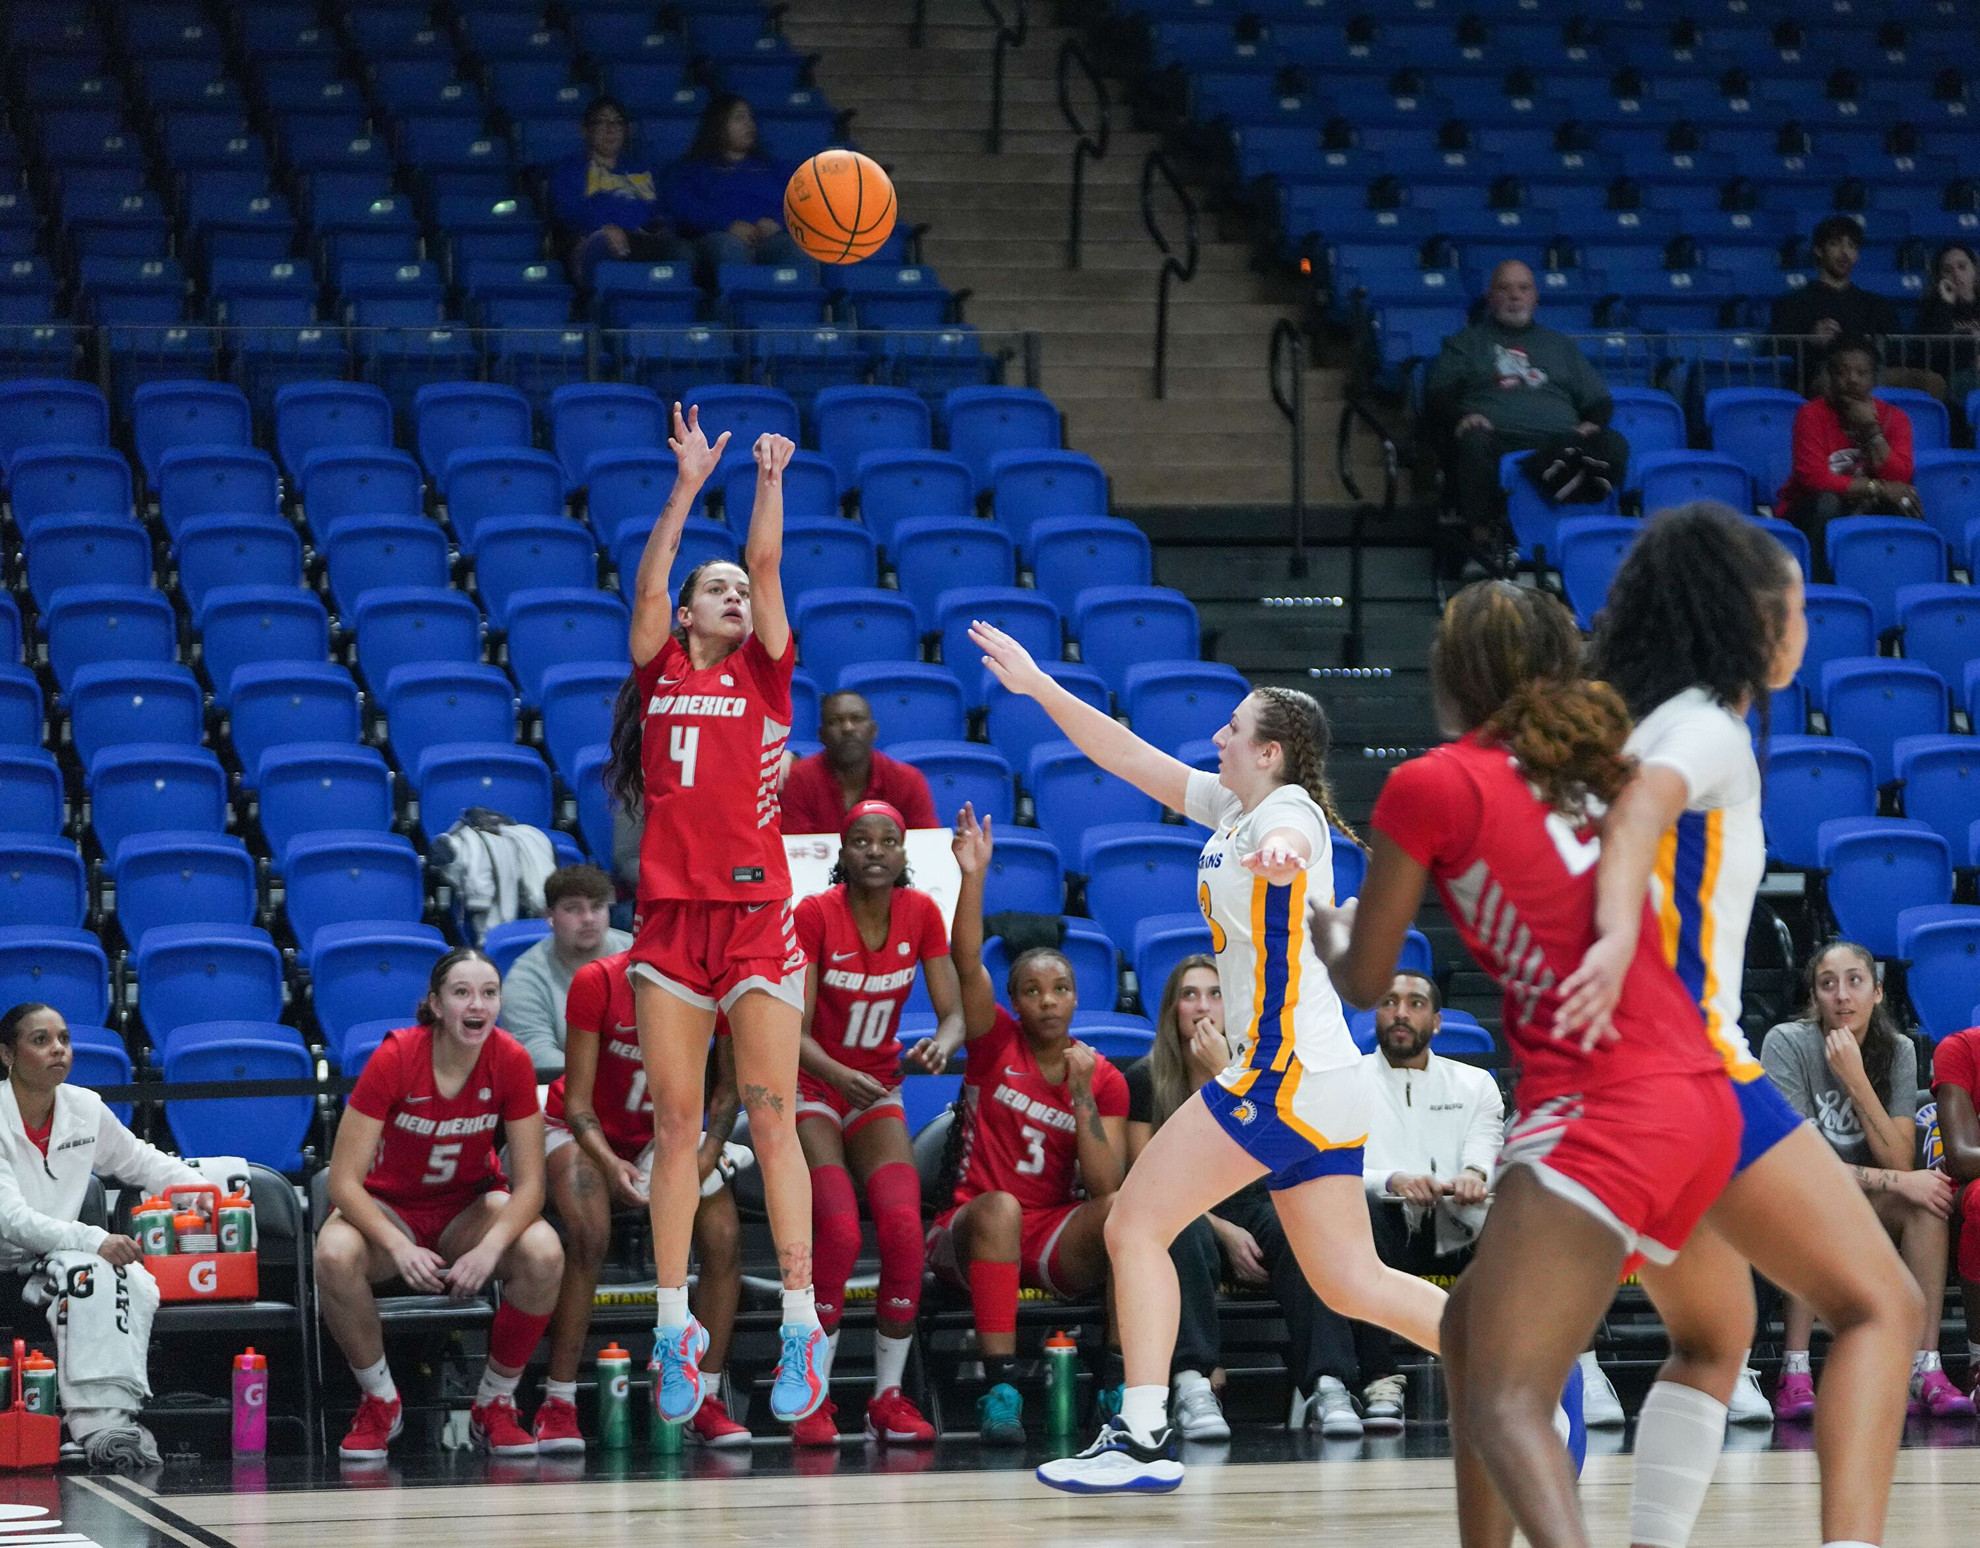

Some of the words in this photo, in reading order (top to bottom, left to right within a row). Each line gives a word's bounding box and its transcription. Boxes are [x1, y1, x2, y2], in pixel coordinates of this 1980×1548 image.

[670, 695, 747, 717] MEXICO
[670, 725, 700, 787] 4
[824, 968, 865, 992] NEW
[842, 998, 896, 1049] 10
[625, 1068, 655, 1112] 1
[993, 1083, 1031, 1113] NEW
[394, 1111, 437, 1135] NEW
[434, 1112, 499, 1137] MEXICO
[421, 1142, 463, 1185] 5
[1015, 1124, 1047, 1175] 3
[146, 1226, 167, 1250] G
[221, 1223, 239, 1247] G
[67, 1263, 95, 1299] G
[188, 1260, 218, 1294] G
[245, 1383, 264, 1406] G
[611, 1374, 629, 1397] G
